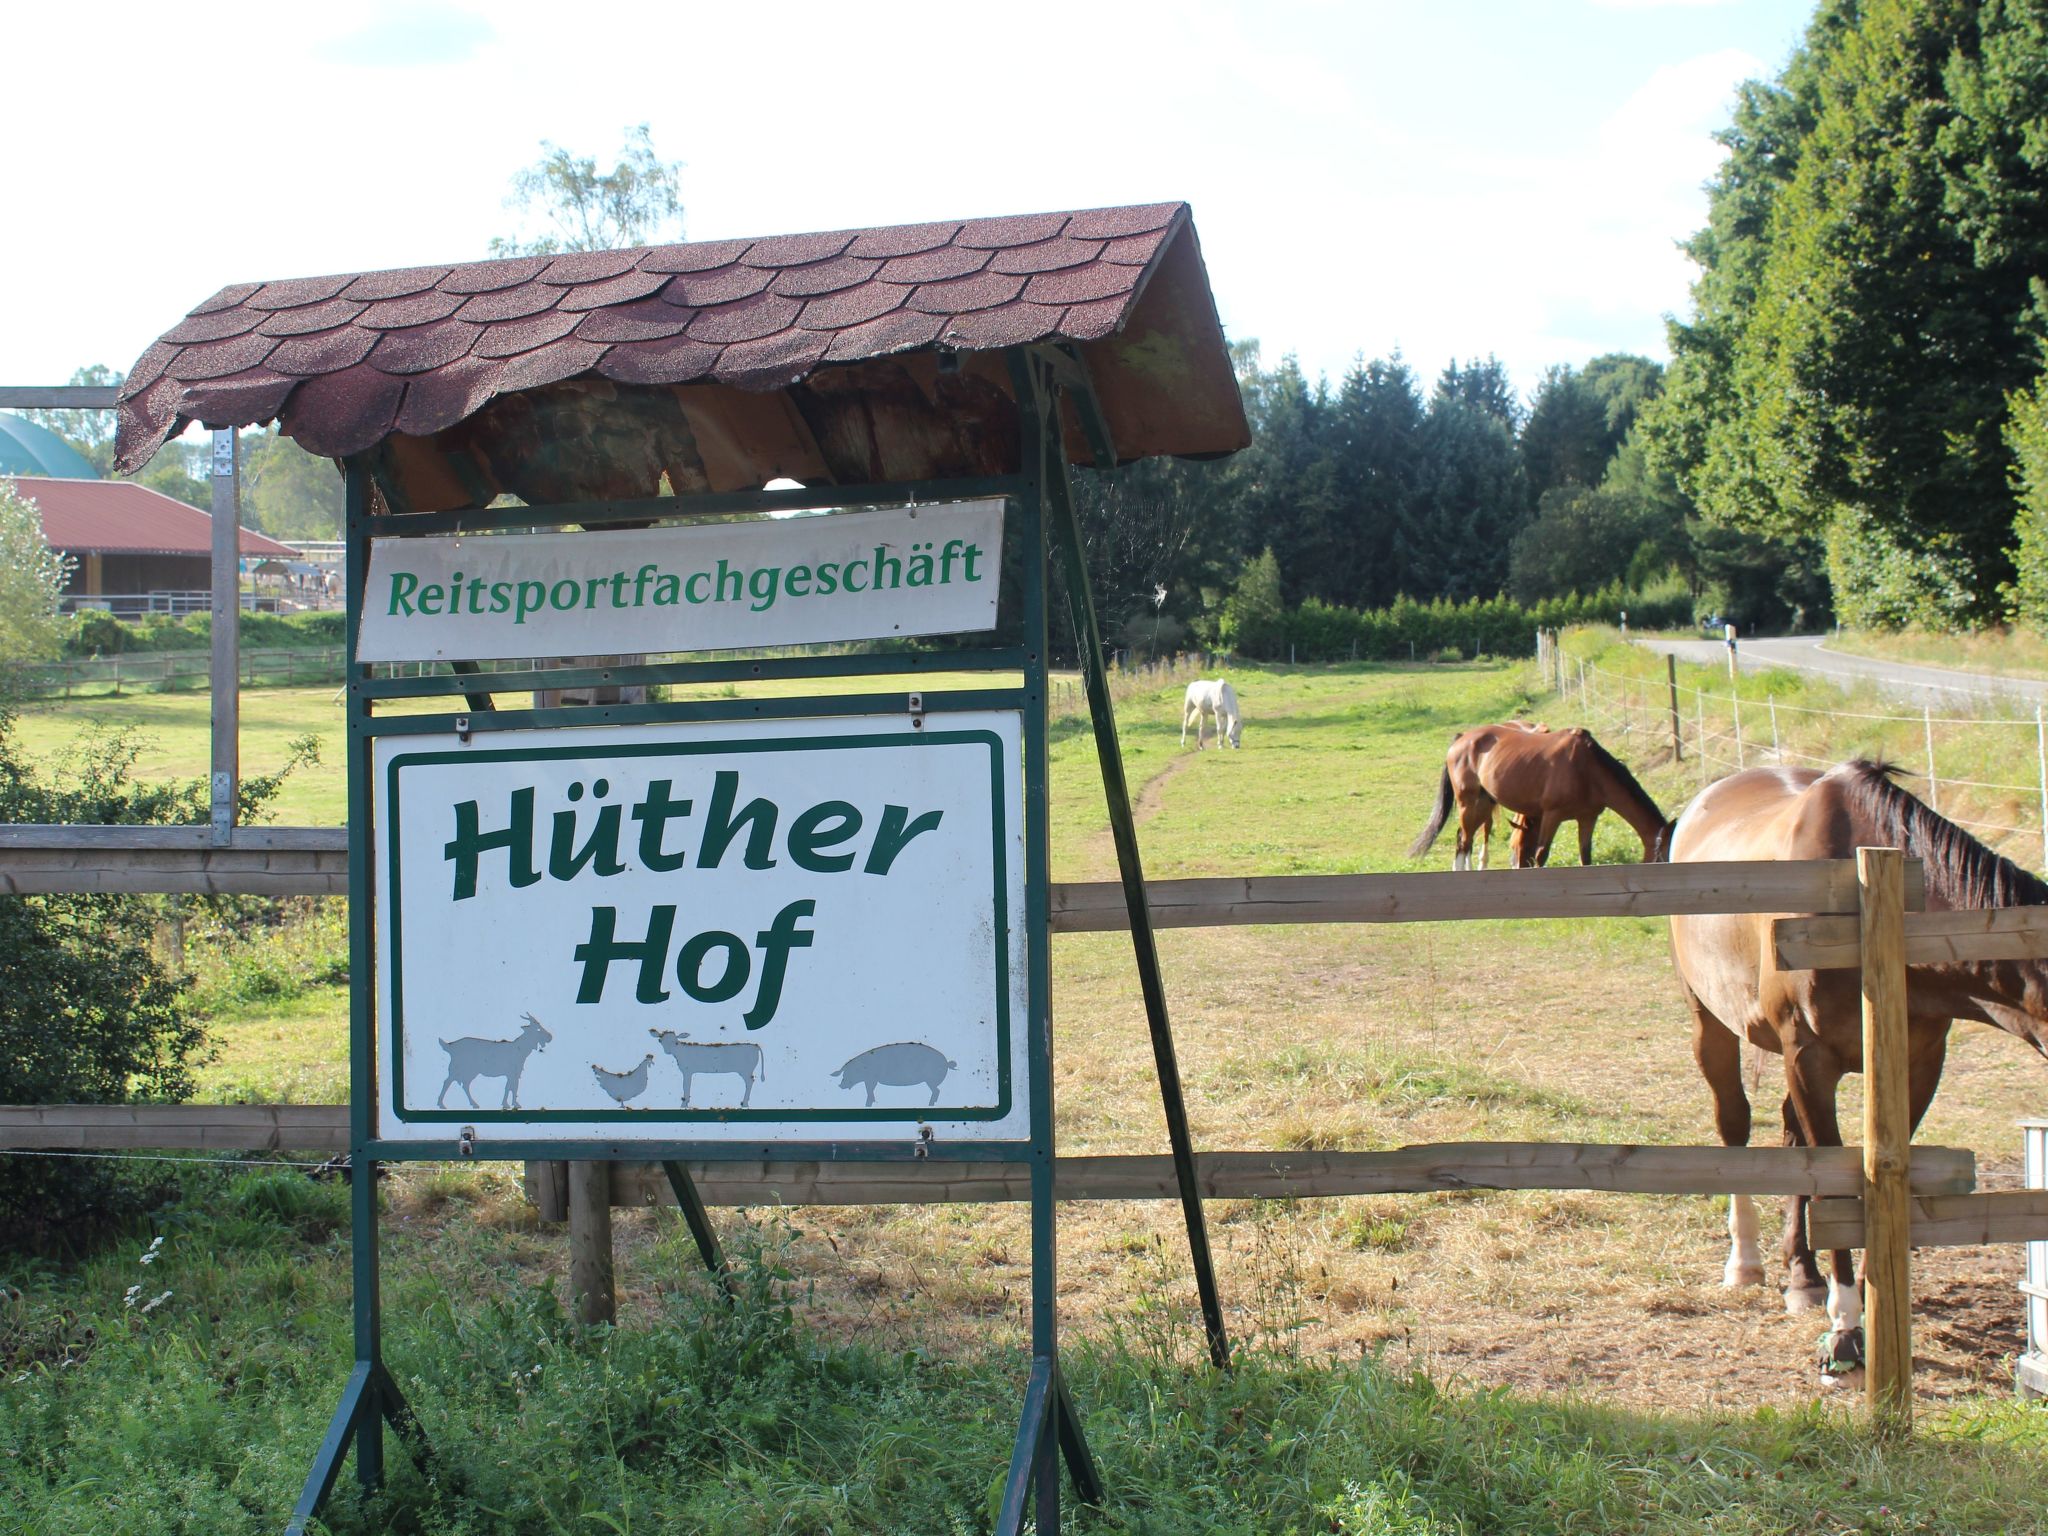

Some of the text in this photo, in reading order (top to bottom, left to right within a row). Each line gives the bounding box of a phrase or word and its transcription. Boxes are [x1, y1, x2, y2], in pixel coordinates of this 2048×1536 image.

[386, 538, 985, 625] Reitsportfachgeschäft
[443, 770, 945, 902] Hüther
[572, 898, 817, 1031] Hof
